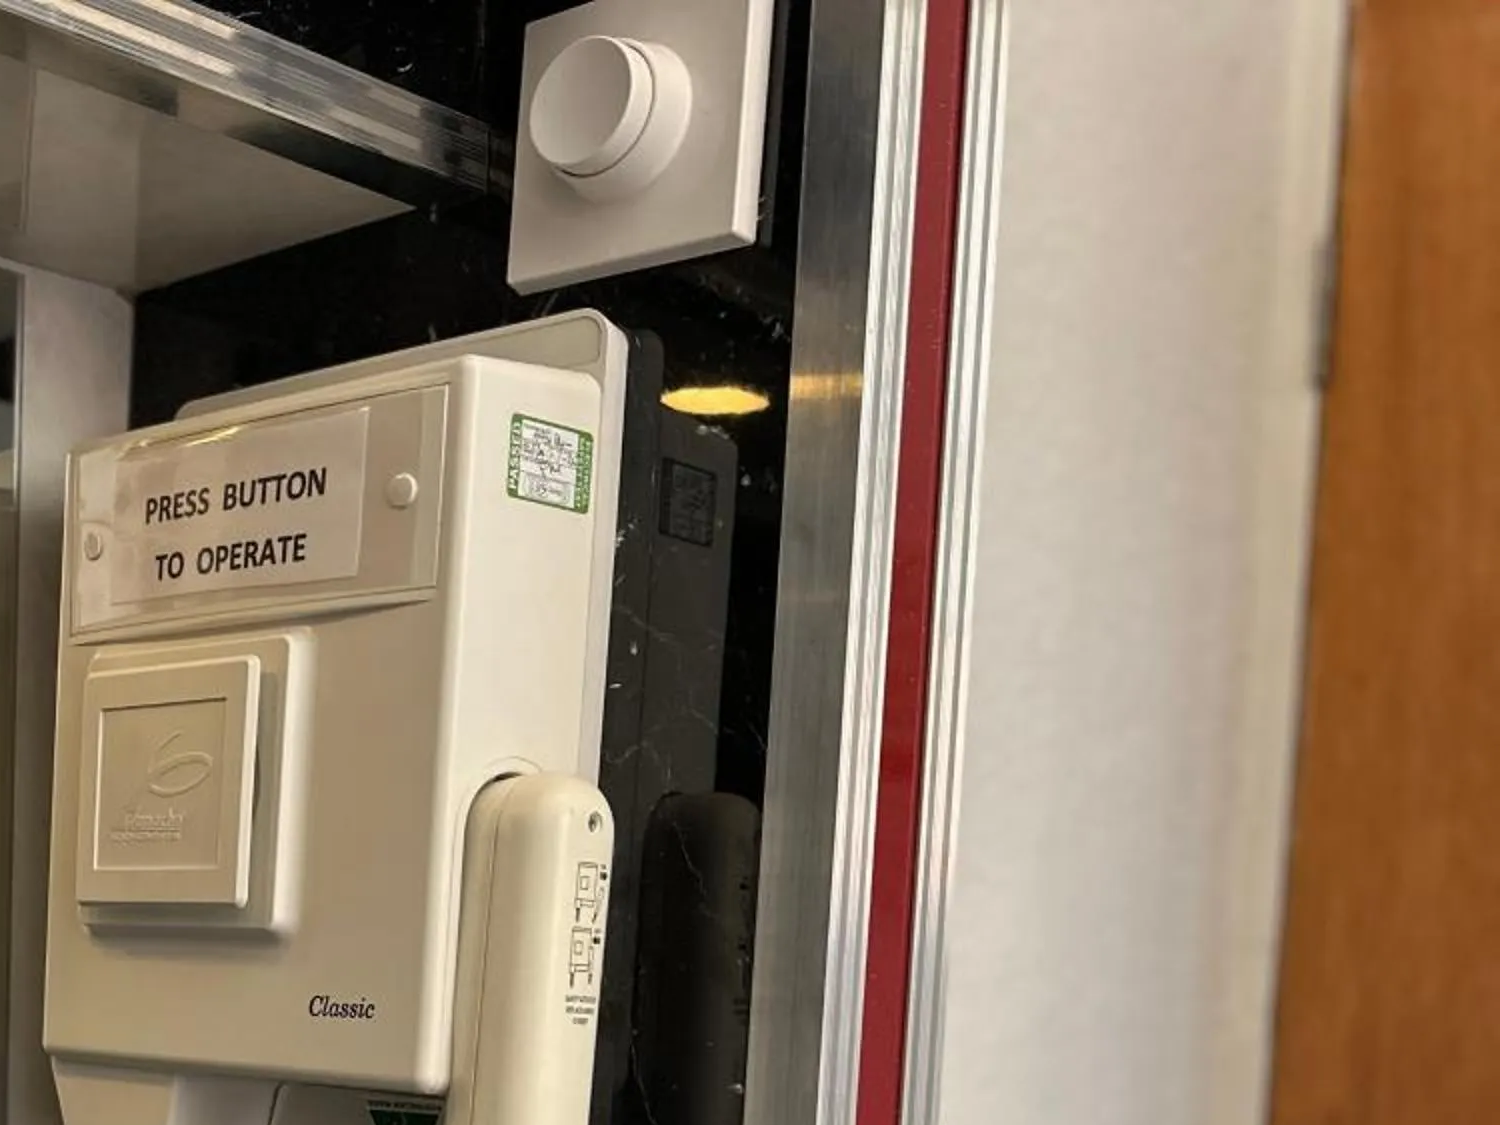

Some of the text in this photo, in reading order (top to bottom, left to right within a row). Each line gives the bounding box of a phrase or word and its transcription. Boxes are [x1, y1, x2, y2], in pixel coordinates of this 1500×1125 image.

[145, 467, 327, 525] PRESS BUTTON
[155, 533, 307, 582] TO OPERATE
[308, 995, 375, 1019] Classic
